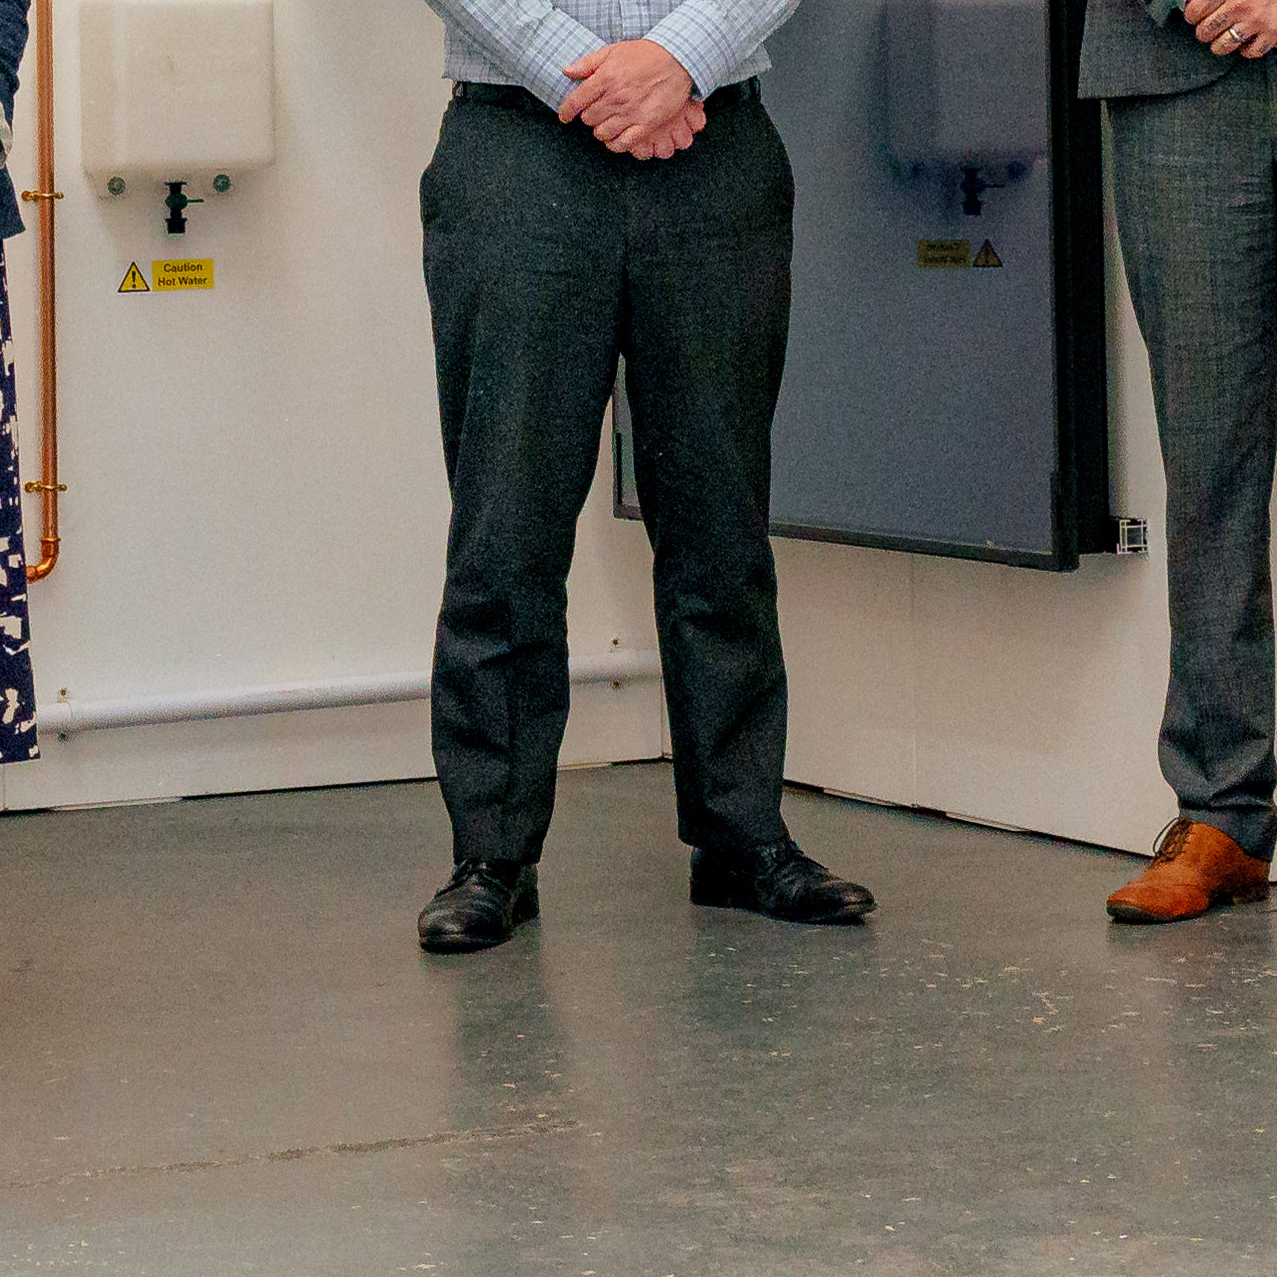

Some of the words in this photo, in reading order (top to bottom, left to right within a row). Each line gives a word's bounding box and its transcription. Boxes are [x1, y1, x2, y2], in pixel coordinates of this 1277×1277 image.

[163, 262, 203, 273] Caution
[158, 277, 176, 286] Hot
[178, 276, 208, 286] Water
